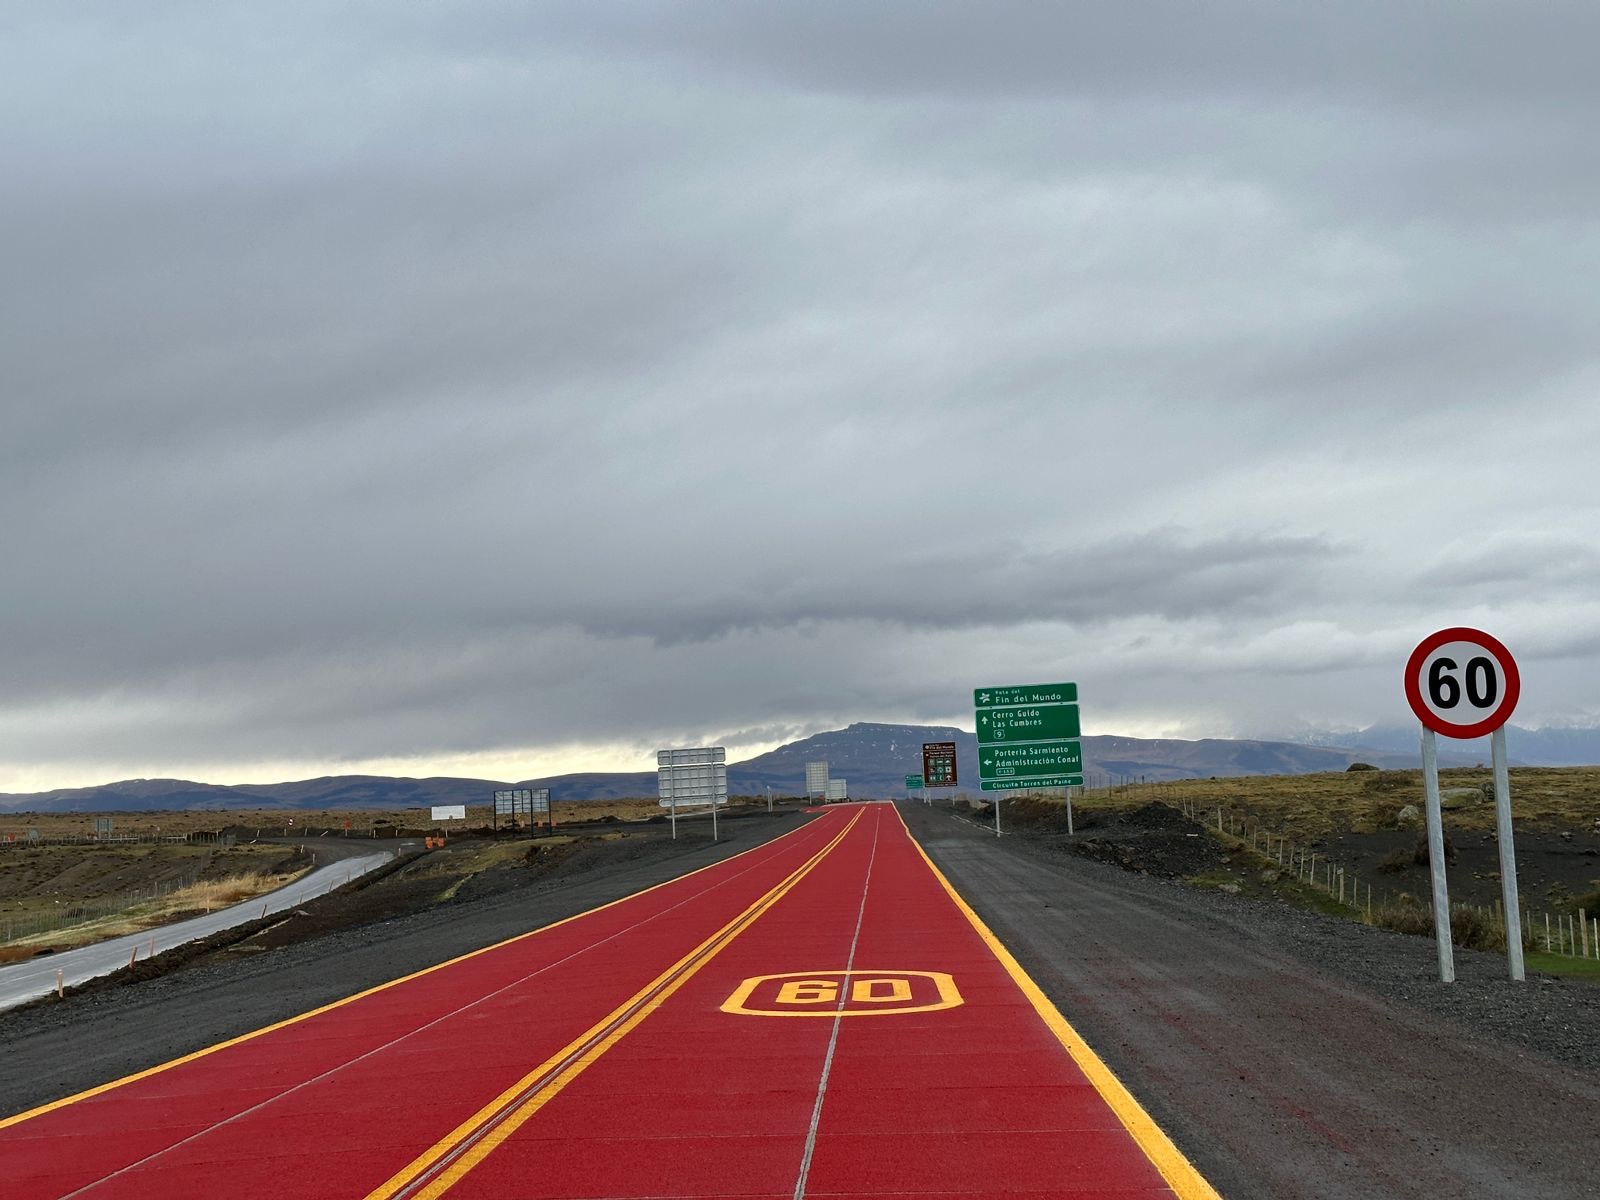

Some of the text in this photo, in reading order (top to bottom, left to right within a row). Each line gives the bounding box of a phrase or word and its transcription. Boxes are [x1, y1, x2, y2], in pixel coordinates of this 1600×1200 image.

[1428, 656, 1497, 710] 60
[995, 693, 1062, 704] Fin del Mundo
[992, 709, 1040, 719] Cerro Guido
[992, 719, 1042, 728] Las Cumbres
[1029, 746, 1069, 755] Sarmiento
[995, 757, 1055, 768] Administración
[775, 979, 913, 1004] 60
